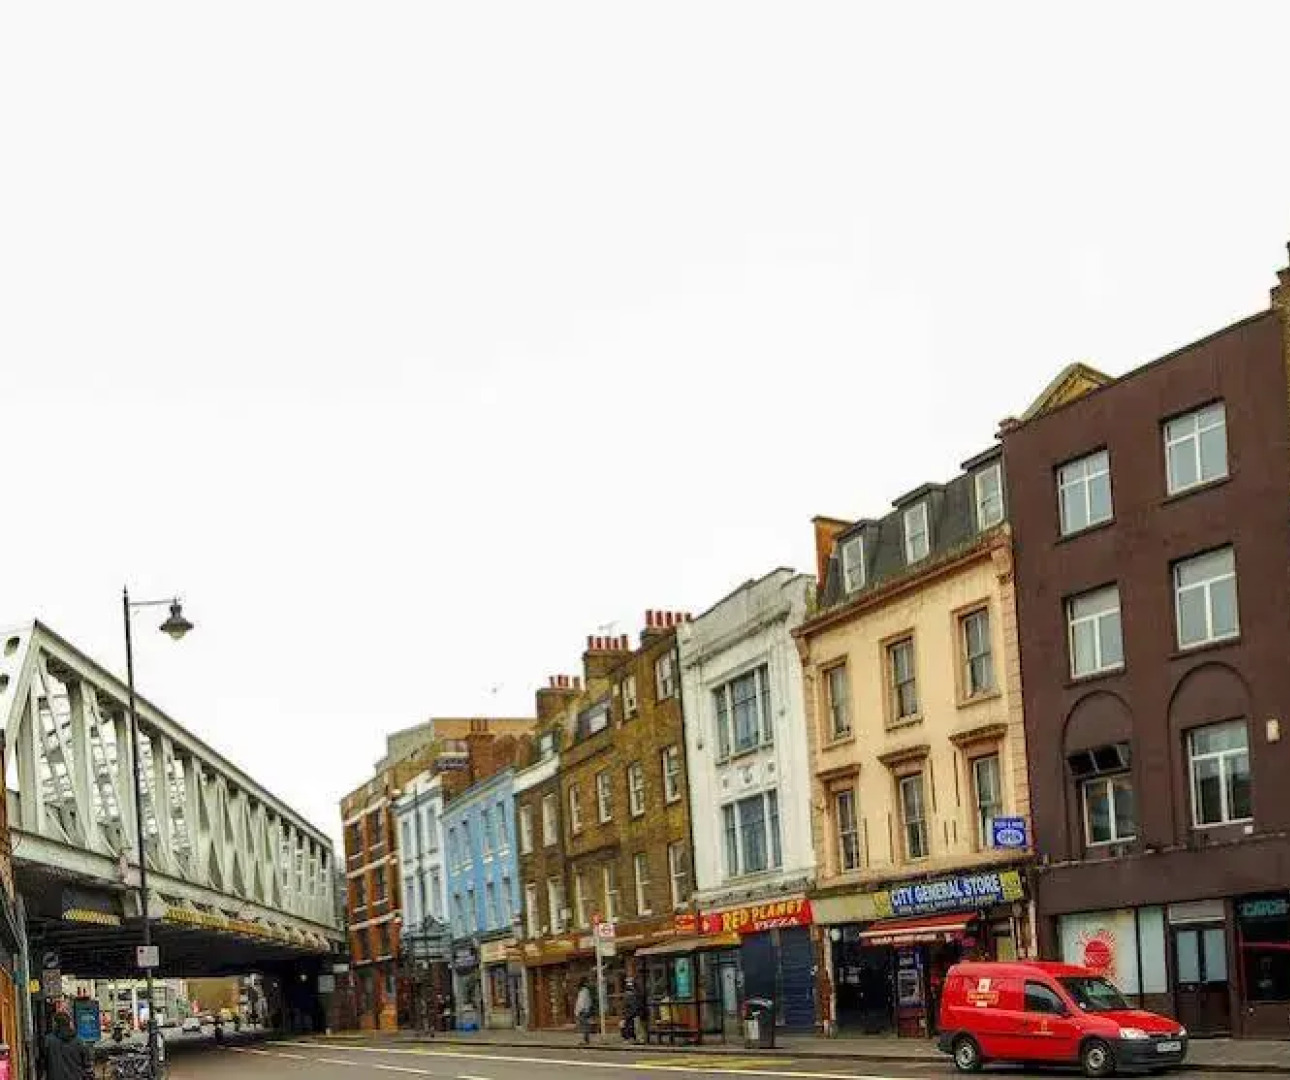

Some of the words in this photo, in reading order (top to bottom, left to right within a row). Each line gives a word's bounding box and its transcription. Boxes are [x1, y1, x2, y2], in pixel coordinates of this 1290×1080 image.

[891, 886, 913, 906] CITY
[915, 877, 963, 903] GENERAL
[965, 872, 1000, 898] STORE
[721, 908, 748, 930] RED
[752, 900, 802, 922] PLANET
[754, 916, 799, 930] PIZZA
